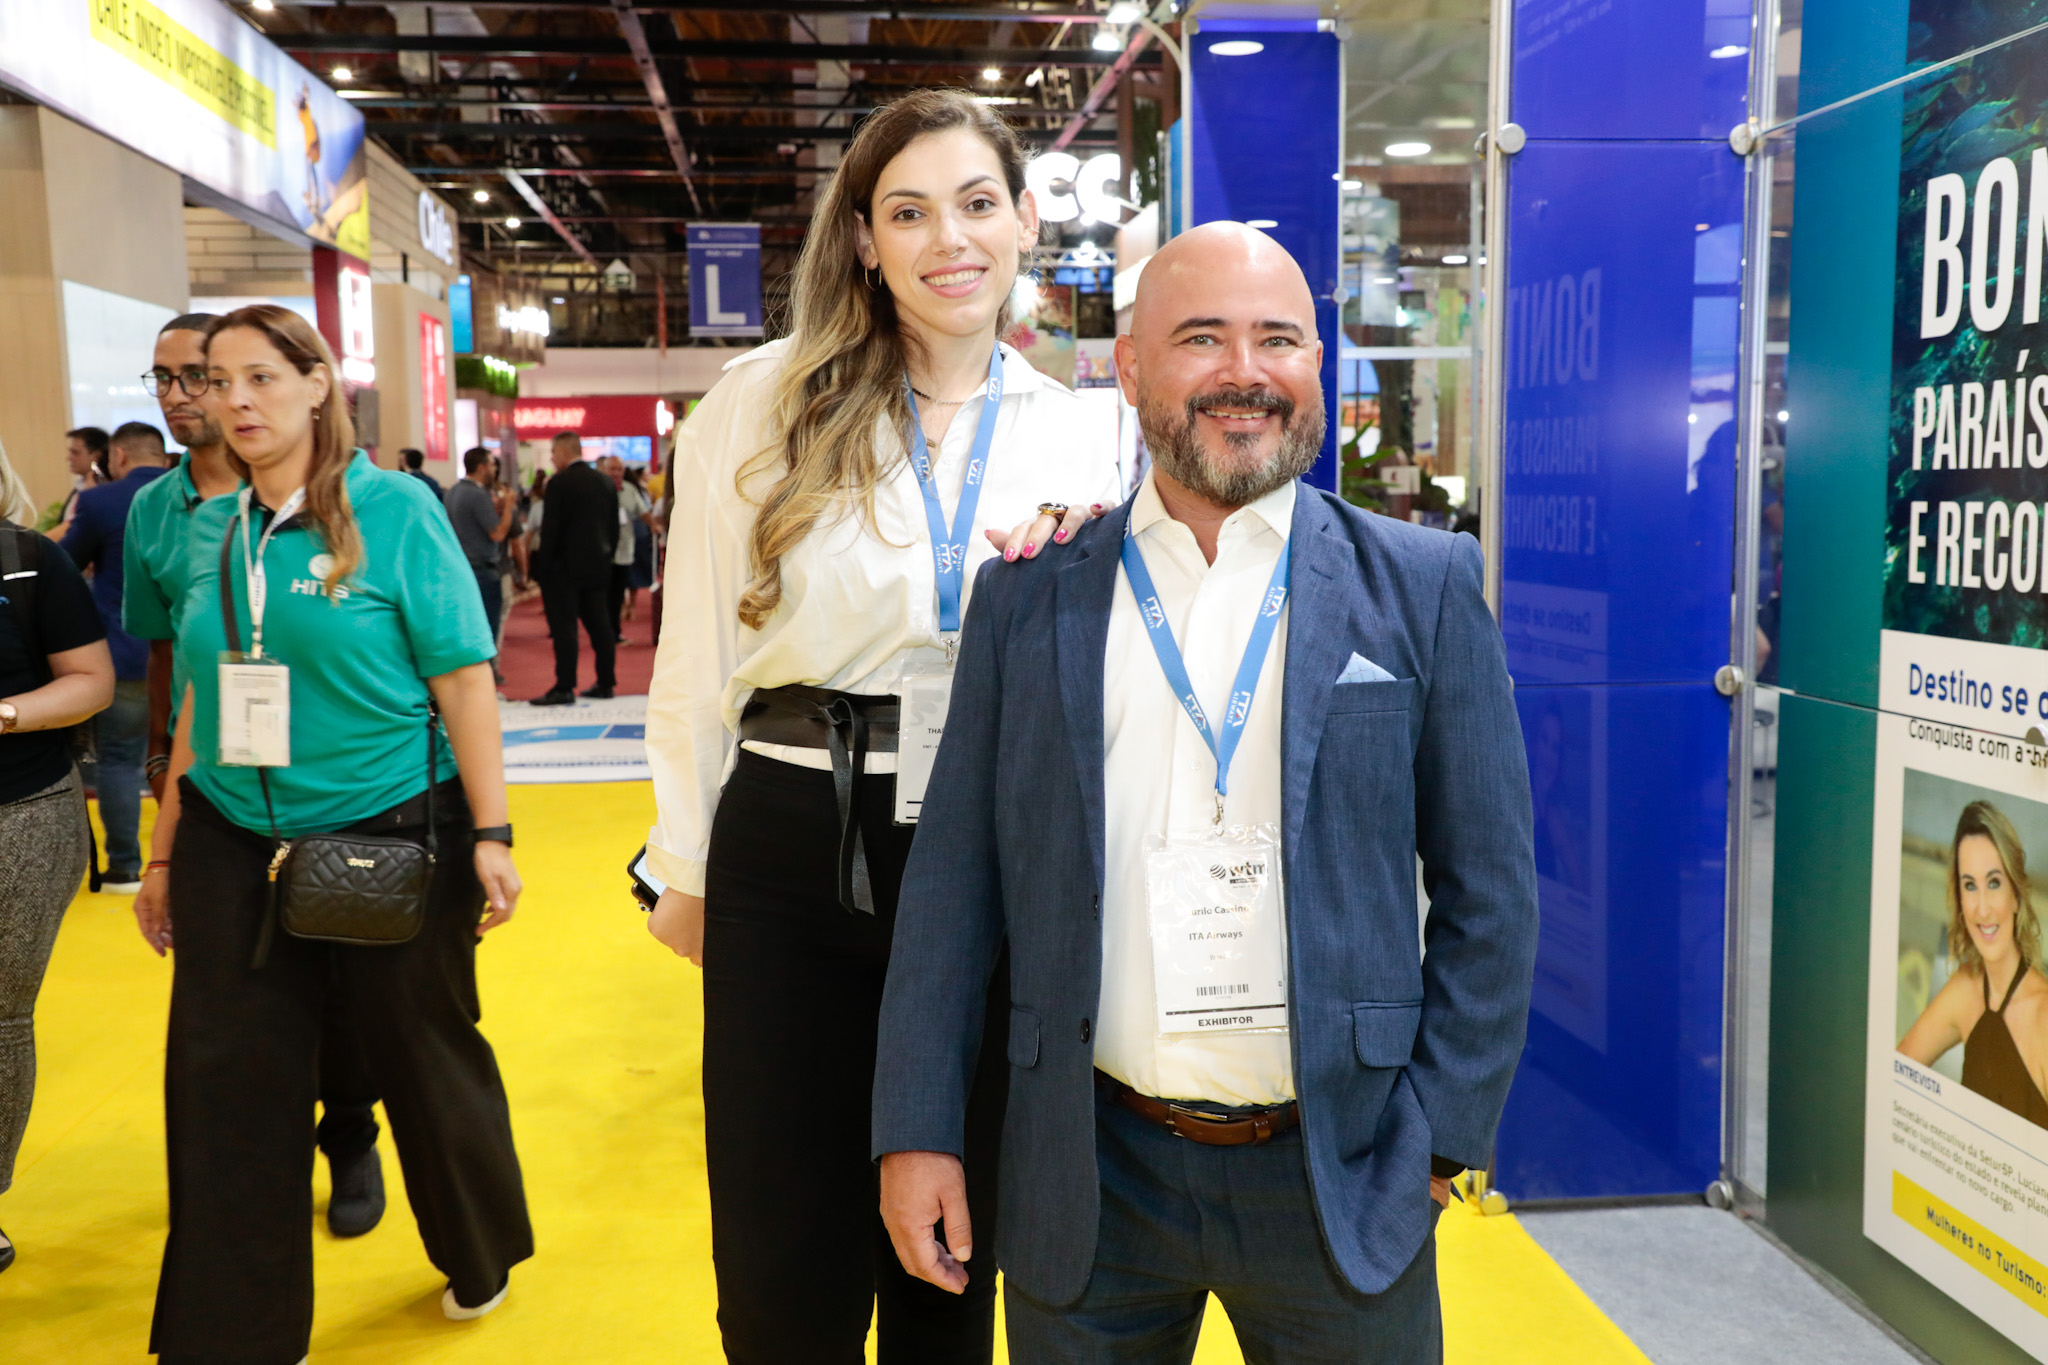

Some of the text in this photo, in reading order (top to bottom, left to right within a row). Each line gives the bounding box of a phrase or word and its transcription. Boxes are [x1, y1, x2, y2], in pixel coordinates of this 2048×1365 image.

[705, 264, 747, 326] L
[1911, 348, 2048, 471] PARAÍS
[966, 458, 981, 485] ITA
[940, 543, 953, 575] ITA
[1907, 500, 2048, 594] E RECO
[1146, 596, 1165, 629] ITA
[1266, 586, 1287, 618] ITA
[1909, 662, 1993, 710] Destino
[2001, 685, 2028, 716] se
[1185, 693, 1207, 731] ITA
[1232, 690, 1251, 728] ITA
[1908, 718, 1974, 751] Conquista
[1979, 737, 2010, 761] com
[1190, 906, 1213, 916] urilo
[1189, 930, 1243, 941] ITA Airways
[1198, 1015, 1254, 1028] EXHIBITOR
[1894, 1059, 1942, 1096] ENTREVISTA
[1968, 1176, 1989, 1197] novo
[1926, 1205, 2047, 1298] Mulheres no Turismo:
